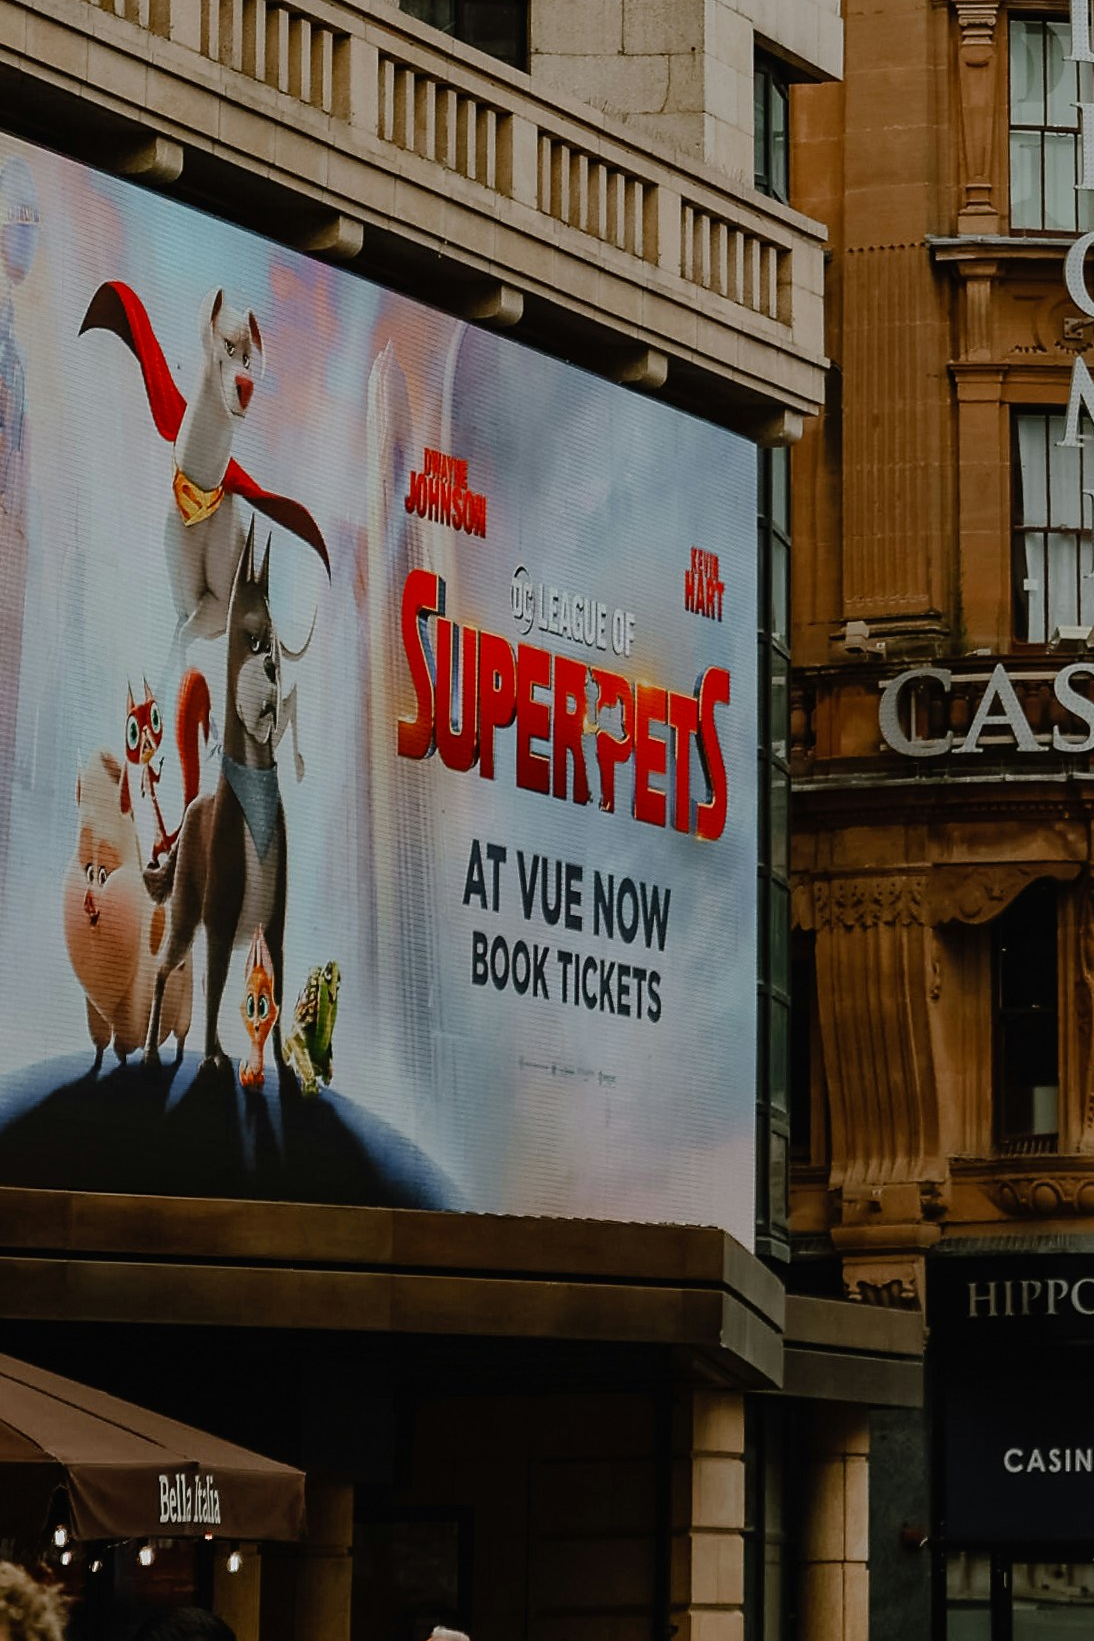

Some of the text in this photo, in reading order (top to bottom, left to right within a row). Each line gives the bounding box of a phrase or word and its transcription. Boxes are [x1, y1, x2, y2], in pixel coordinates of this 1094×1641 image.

[424, 447, 469, 489] DWAYNE
[405, 471, 487, 538] JOHNSON
[690, 546, 720, 581] KEVIN
[538, 584, 608, 650] LEAGUE
[611, 608, 636, 657] OF
[684, 569, 725, 622] HART
[462, 839, 671, 951] AT VUE NOW
[471, 931, 661, 1023] BOOK TICKETS
[159, 1474, 221, 1524] Bella Italia
